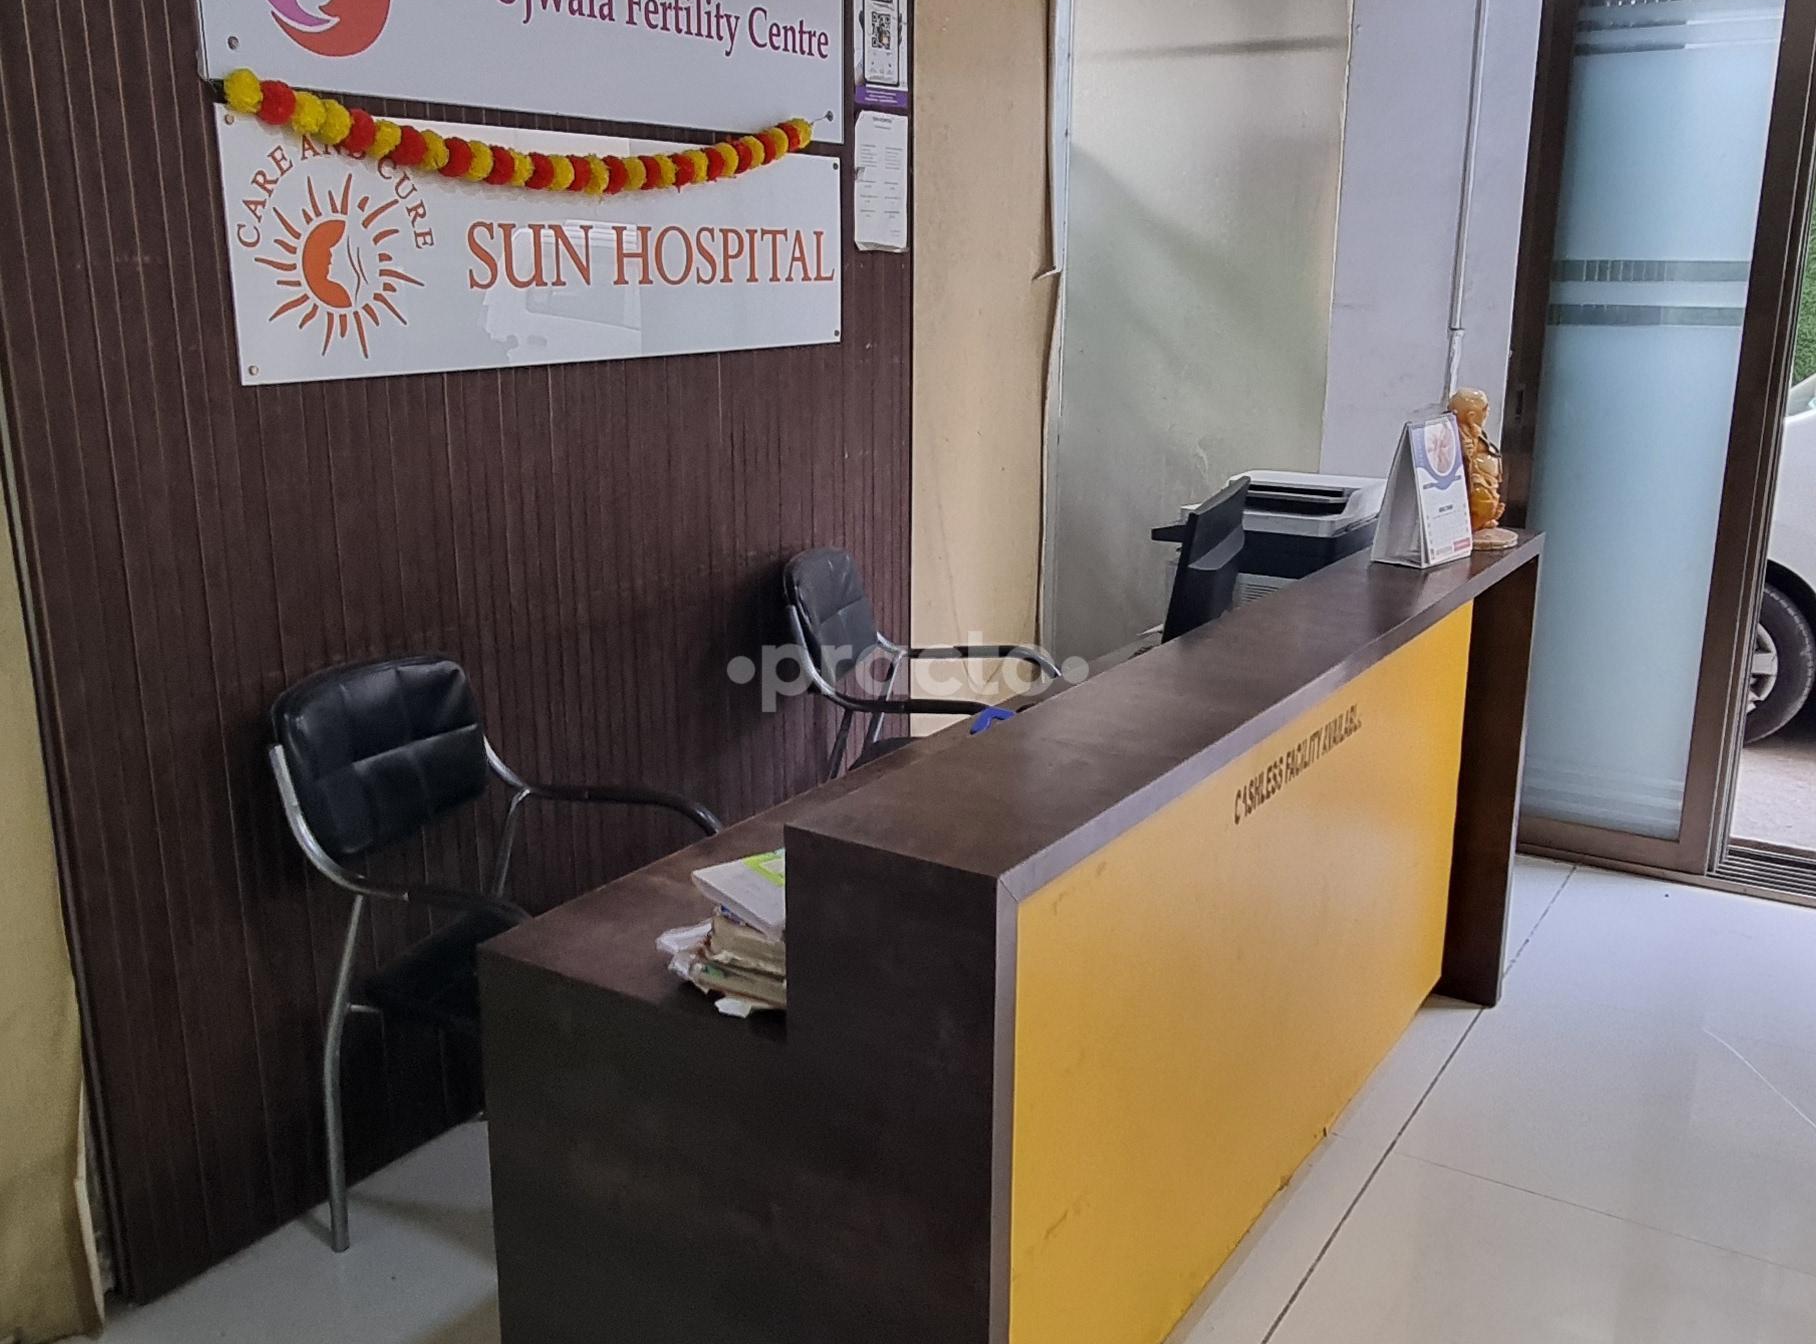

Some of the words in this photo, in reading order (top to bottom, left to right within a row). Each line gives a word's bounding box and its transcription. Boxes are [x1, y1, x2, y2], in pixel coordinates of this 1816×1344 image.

[748, 6, 829, 59] Centre
[236, 144, 295, 248] CARE
[377, 156, 435, 249] CURE
[467, 221, 593, 289] SUN
[612, 225, 835, 286] HOSPITAL
[1234, 756, 1284, 825] CASHLESS
[1285, 727, 1322, 784] FACILITY
[1321, 704, 1362, 757] AVAILABL
